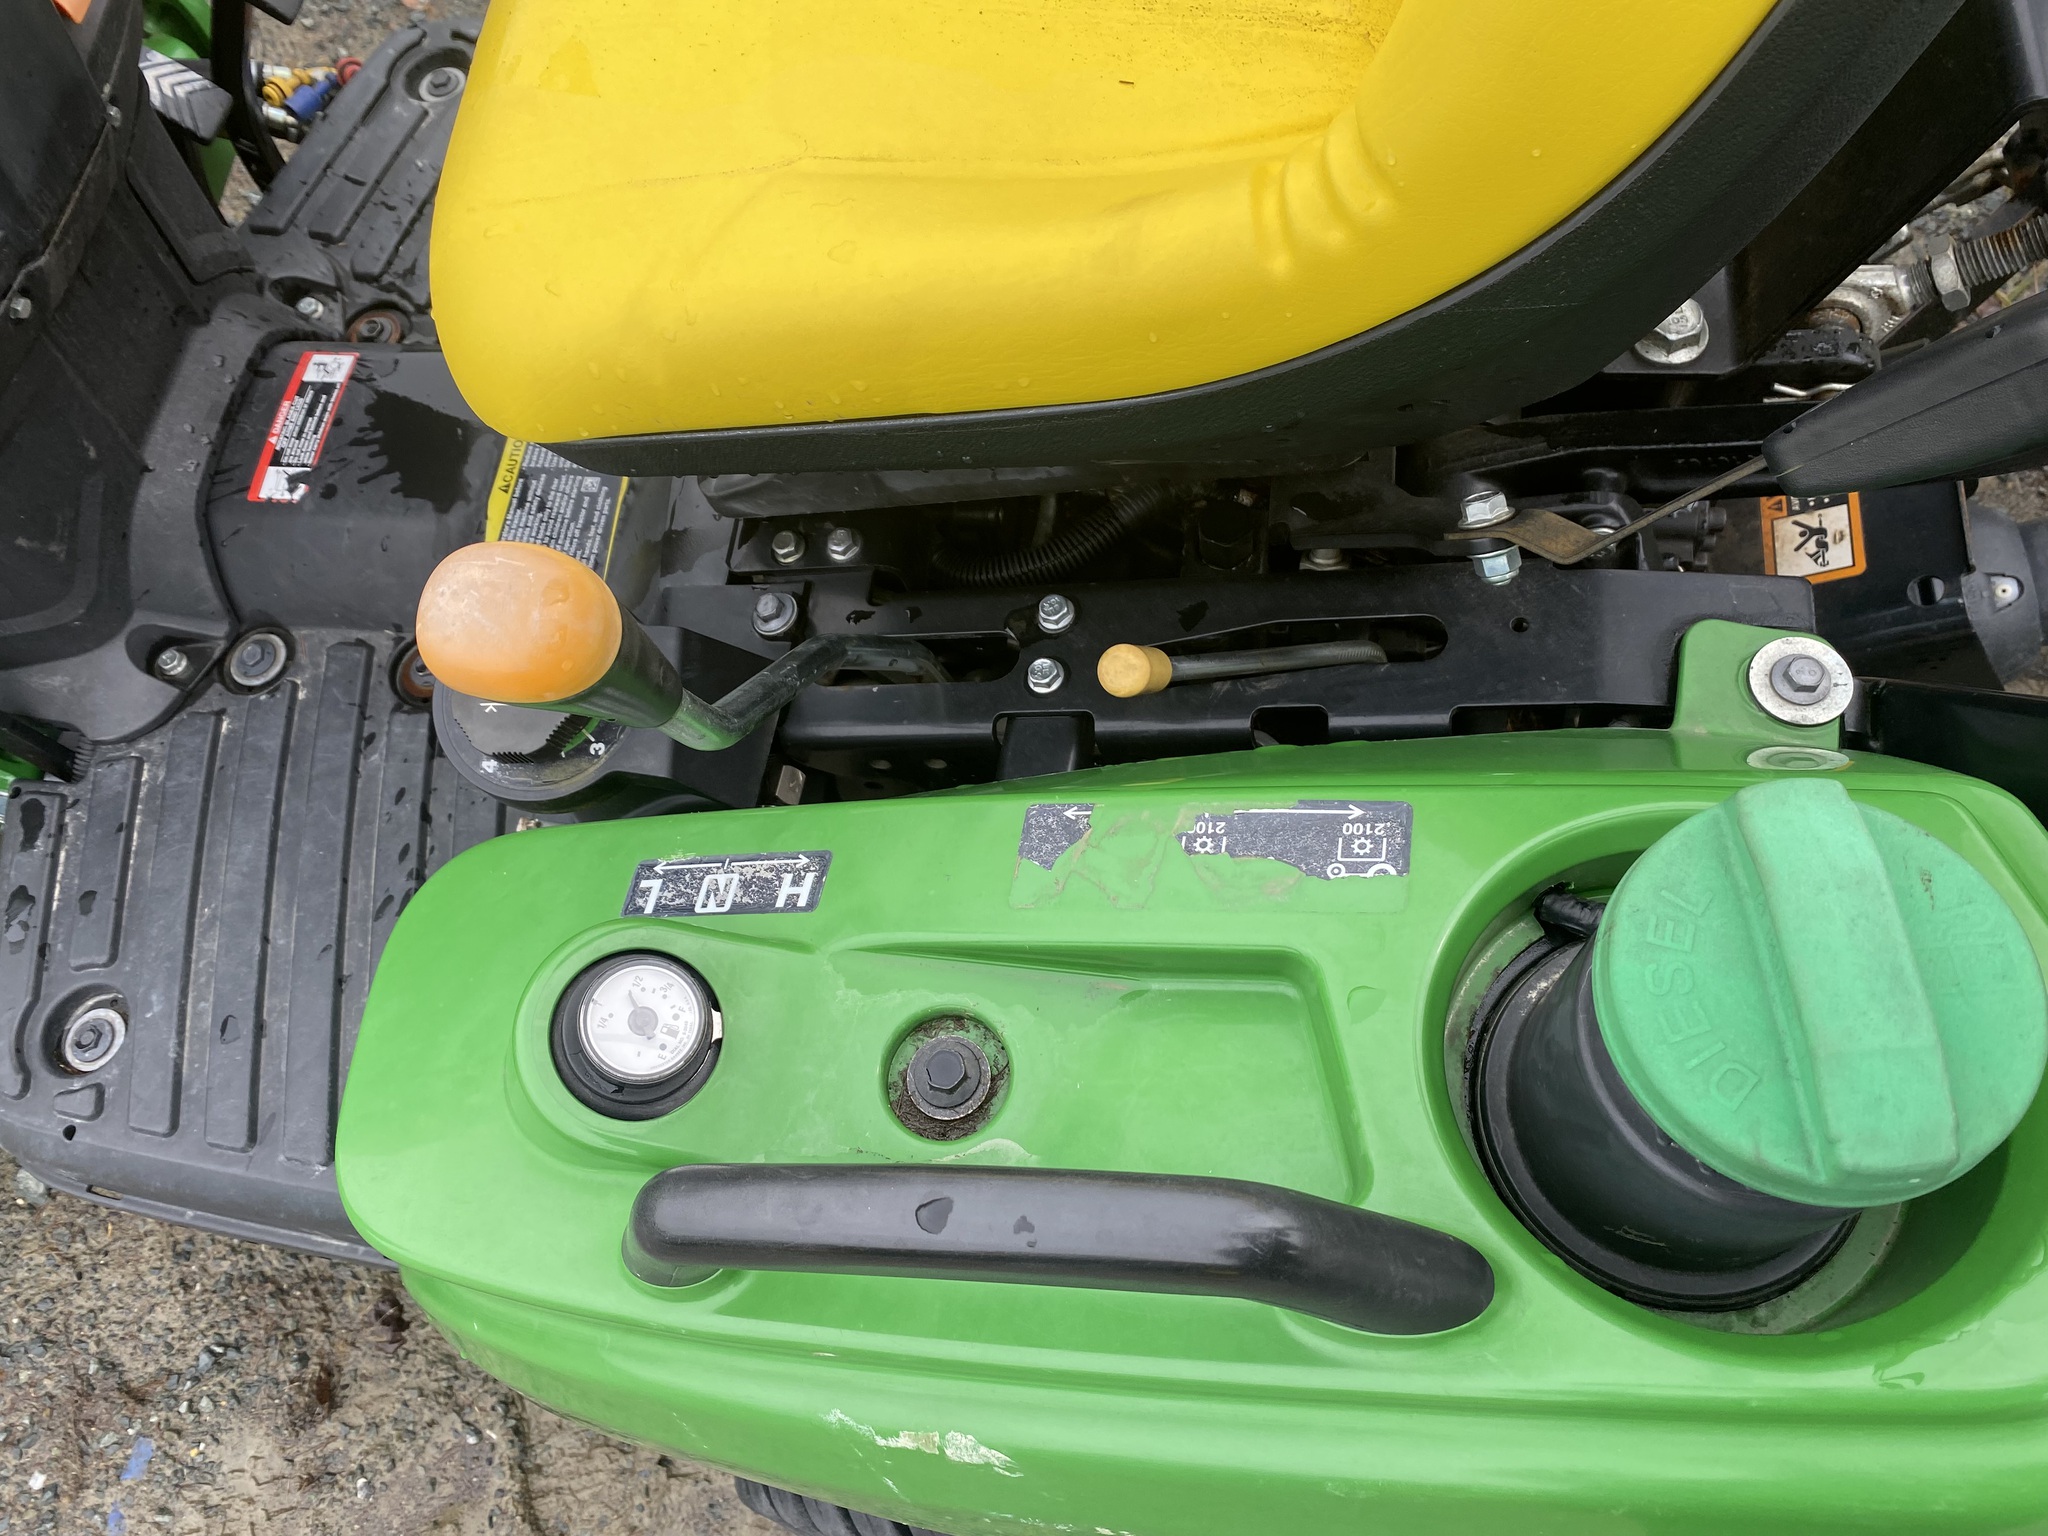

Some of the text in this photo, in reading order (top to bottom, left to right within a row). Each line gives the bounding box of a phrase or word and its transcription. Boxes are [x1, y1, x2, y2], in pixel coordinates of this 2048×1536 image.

[271, 402, 290, 435] DANGER
[502, 438, 523, 483] CAUTIO
[589, 742, 605, 755] 3
[1342, 822, 1385, 835] 2100
[638, 872, 815, 913] H N L
[632, 975, 643, 988] 1/2
[659, 982, 674, 993] 3/4
[1645, 889, 1761, 1113] DIESEL
[597, 1017, 608, 1029] 1/4
